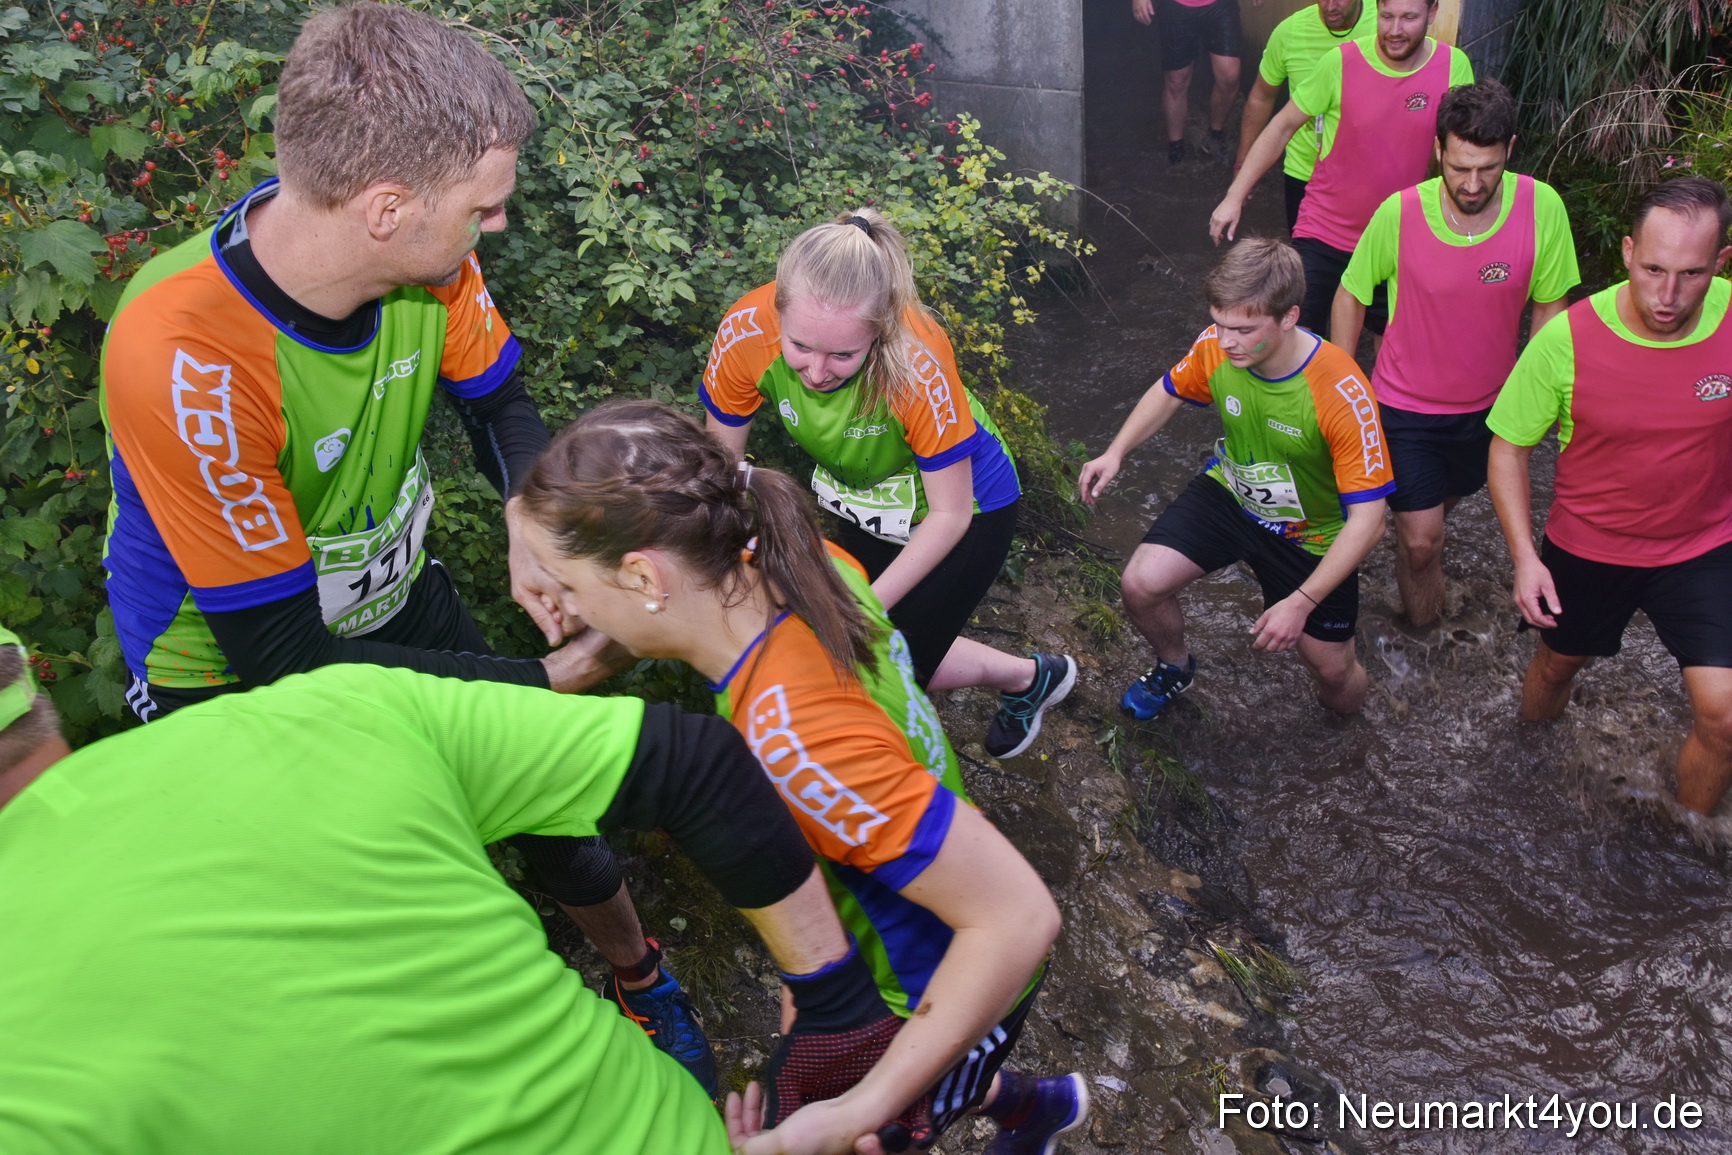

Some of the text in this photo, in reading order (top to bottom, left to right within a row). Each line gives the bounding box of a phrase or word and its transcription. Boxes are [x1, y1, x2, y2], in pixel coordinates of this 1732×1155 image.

[843, 423, 889, 440] BOCK
[904, 341, 958, 438] OCK
[1267, 418, 1303, 438] BOCK
[1335, 374, 1384, 477] BOCK
[171, 347, 289, 552] BOCK
[747, 684, 892, 847] BOCK
